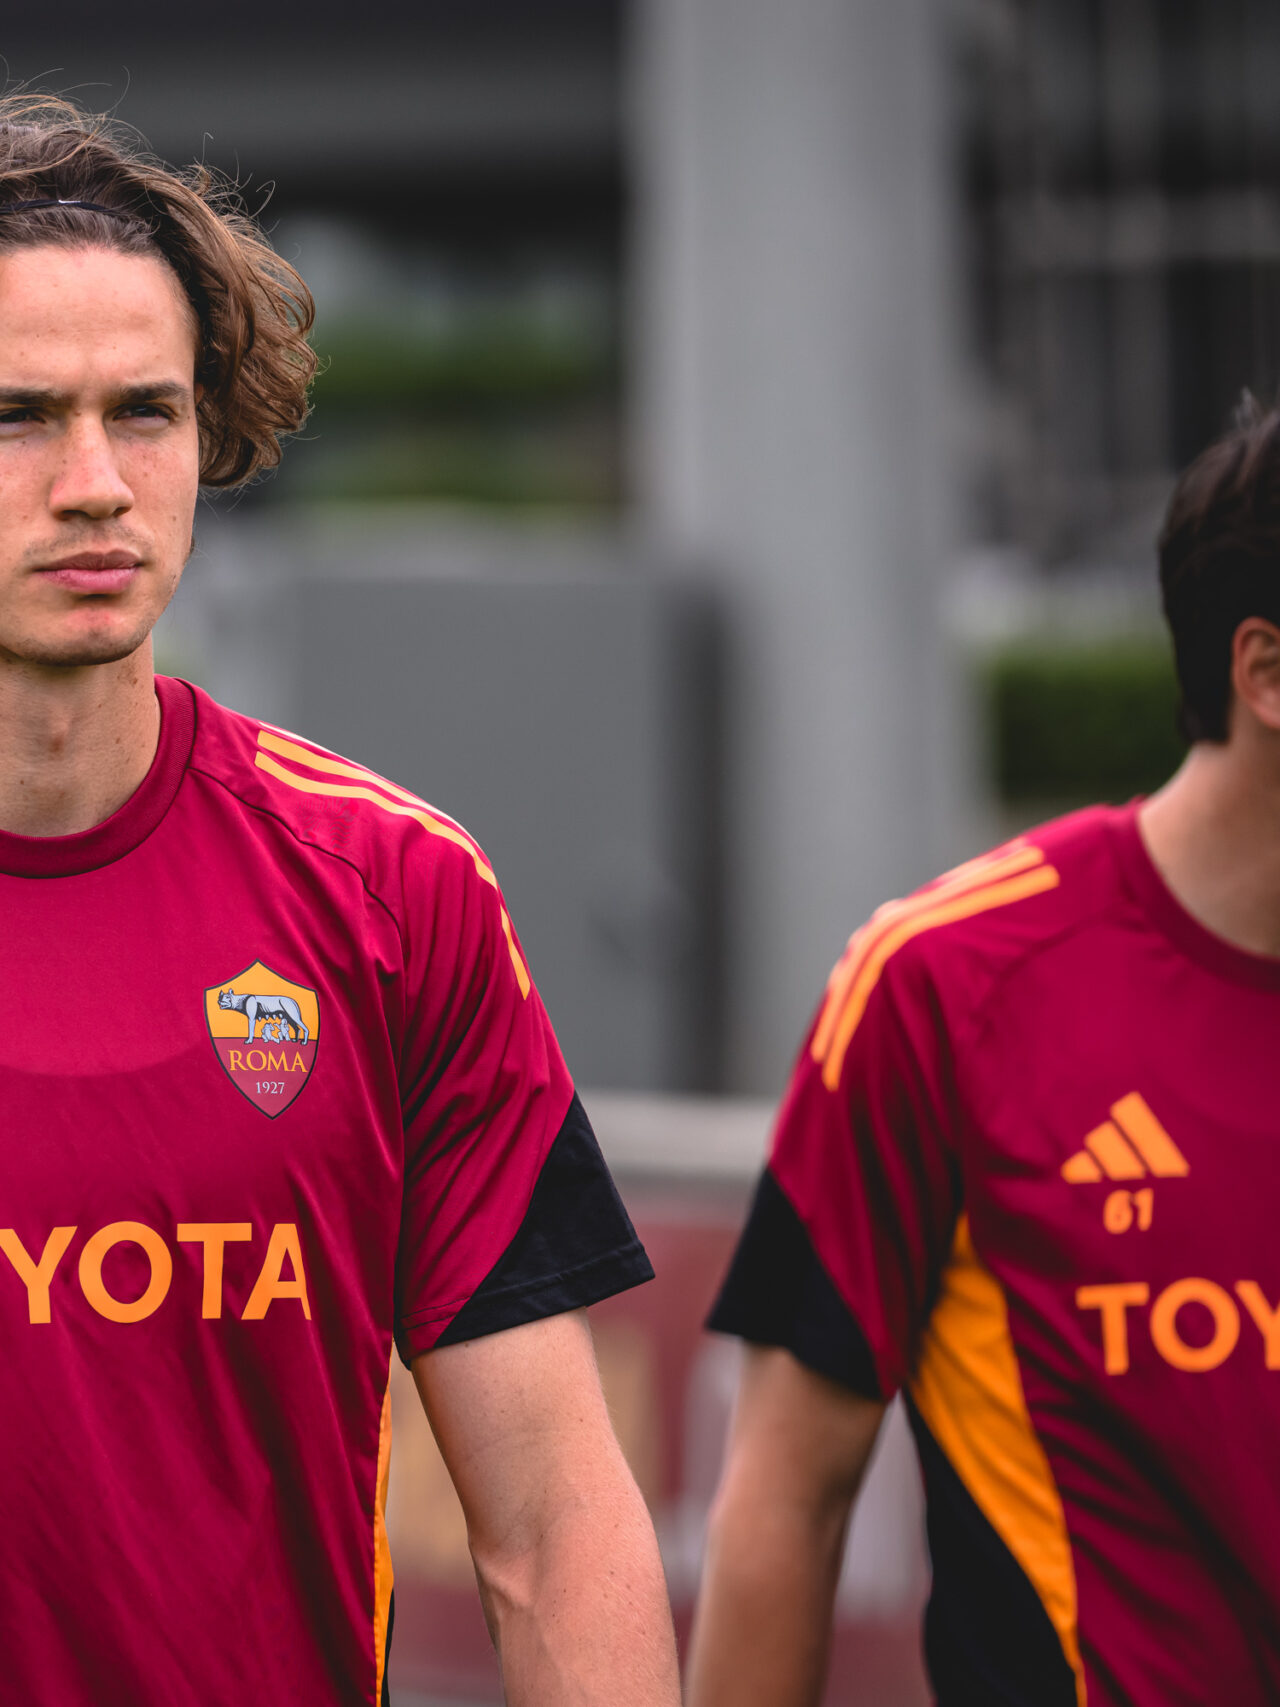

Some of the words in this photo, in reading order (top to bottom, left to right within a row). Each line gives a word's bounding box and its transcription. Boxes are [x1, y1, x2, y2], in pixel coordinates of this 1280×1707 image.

[228, 1050, 308, 1073] ROMA
[255, 1081, 285, 1094] 1927
[1103, 1188, 1154, 1234] 61
